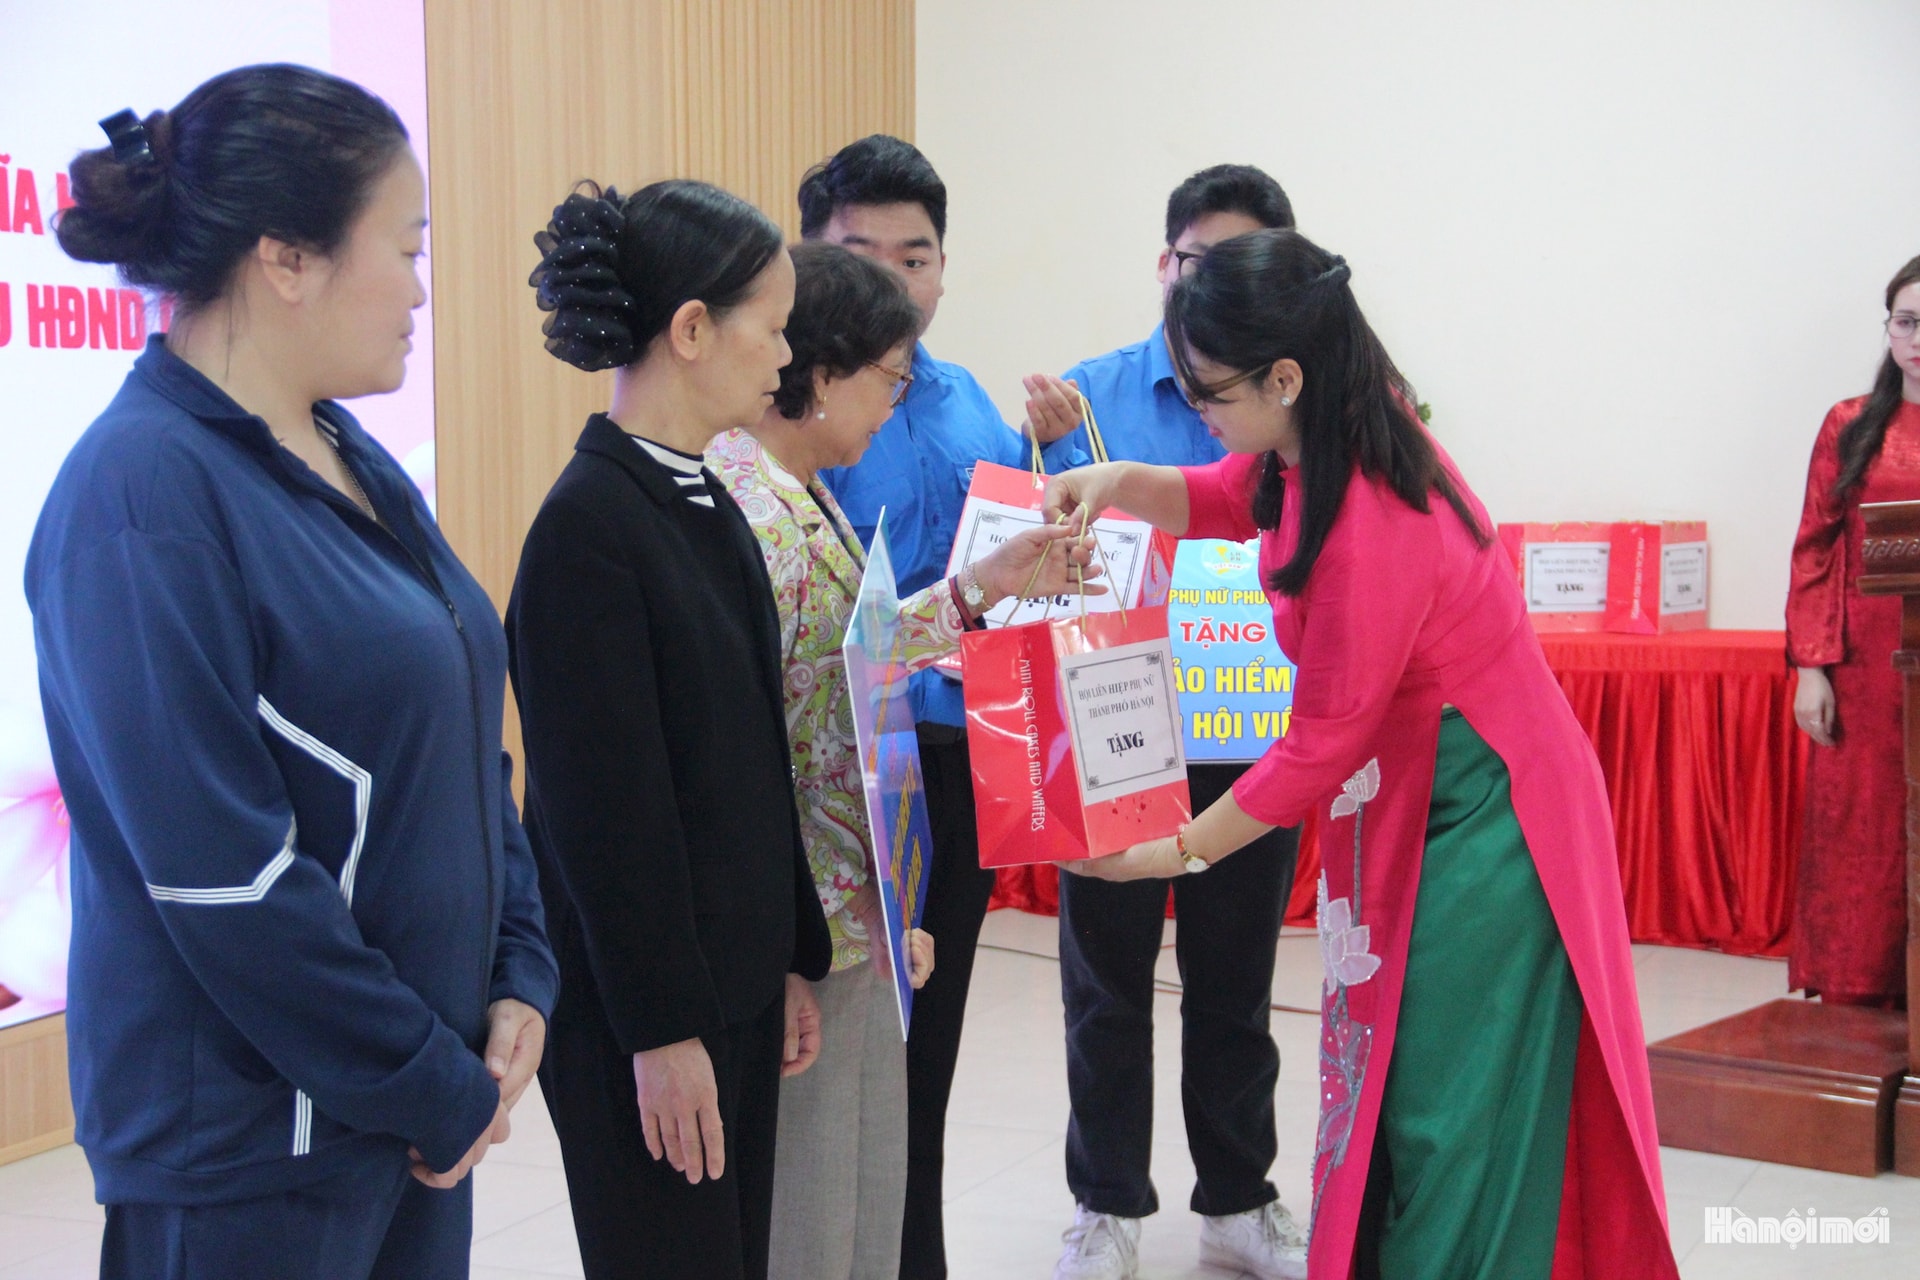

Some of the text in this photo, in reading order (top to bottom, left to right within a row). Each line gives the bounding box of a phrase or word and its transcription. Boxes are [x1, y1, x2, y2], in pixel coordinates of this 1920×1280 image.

[27, 283, 147, 351] HĐND
[1168, 589, 1200, 606] PHỤ
[1205, 586, 1229, 604] NỮ
[1180, 616, 1267, 649] TẶNG
[1108, 681, 1129, 695] HIỆP
[1215, 656, 1291, 693] HIỂM
[1022, 687, 1037, 722] ROLL
[1193, 706, 1242, 744] HỘI
[1106, 731, 1145, 758] TẶNG
